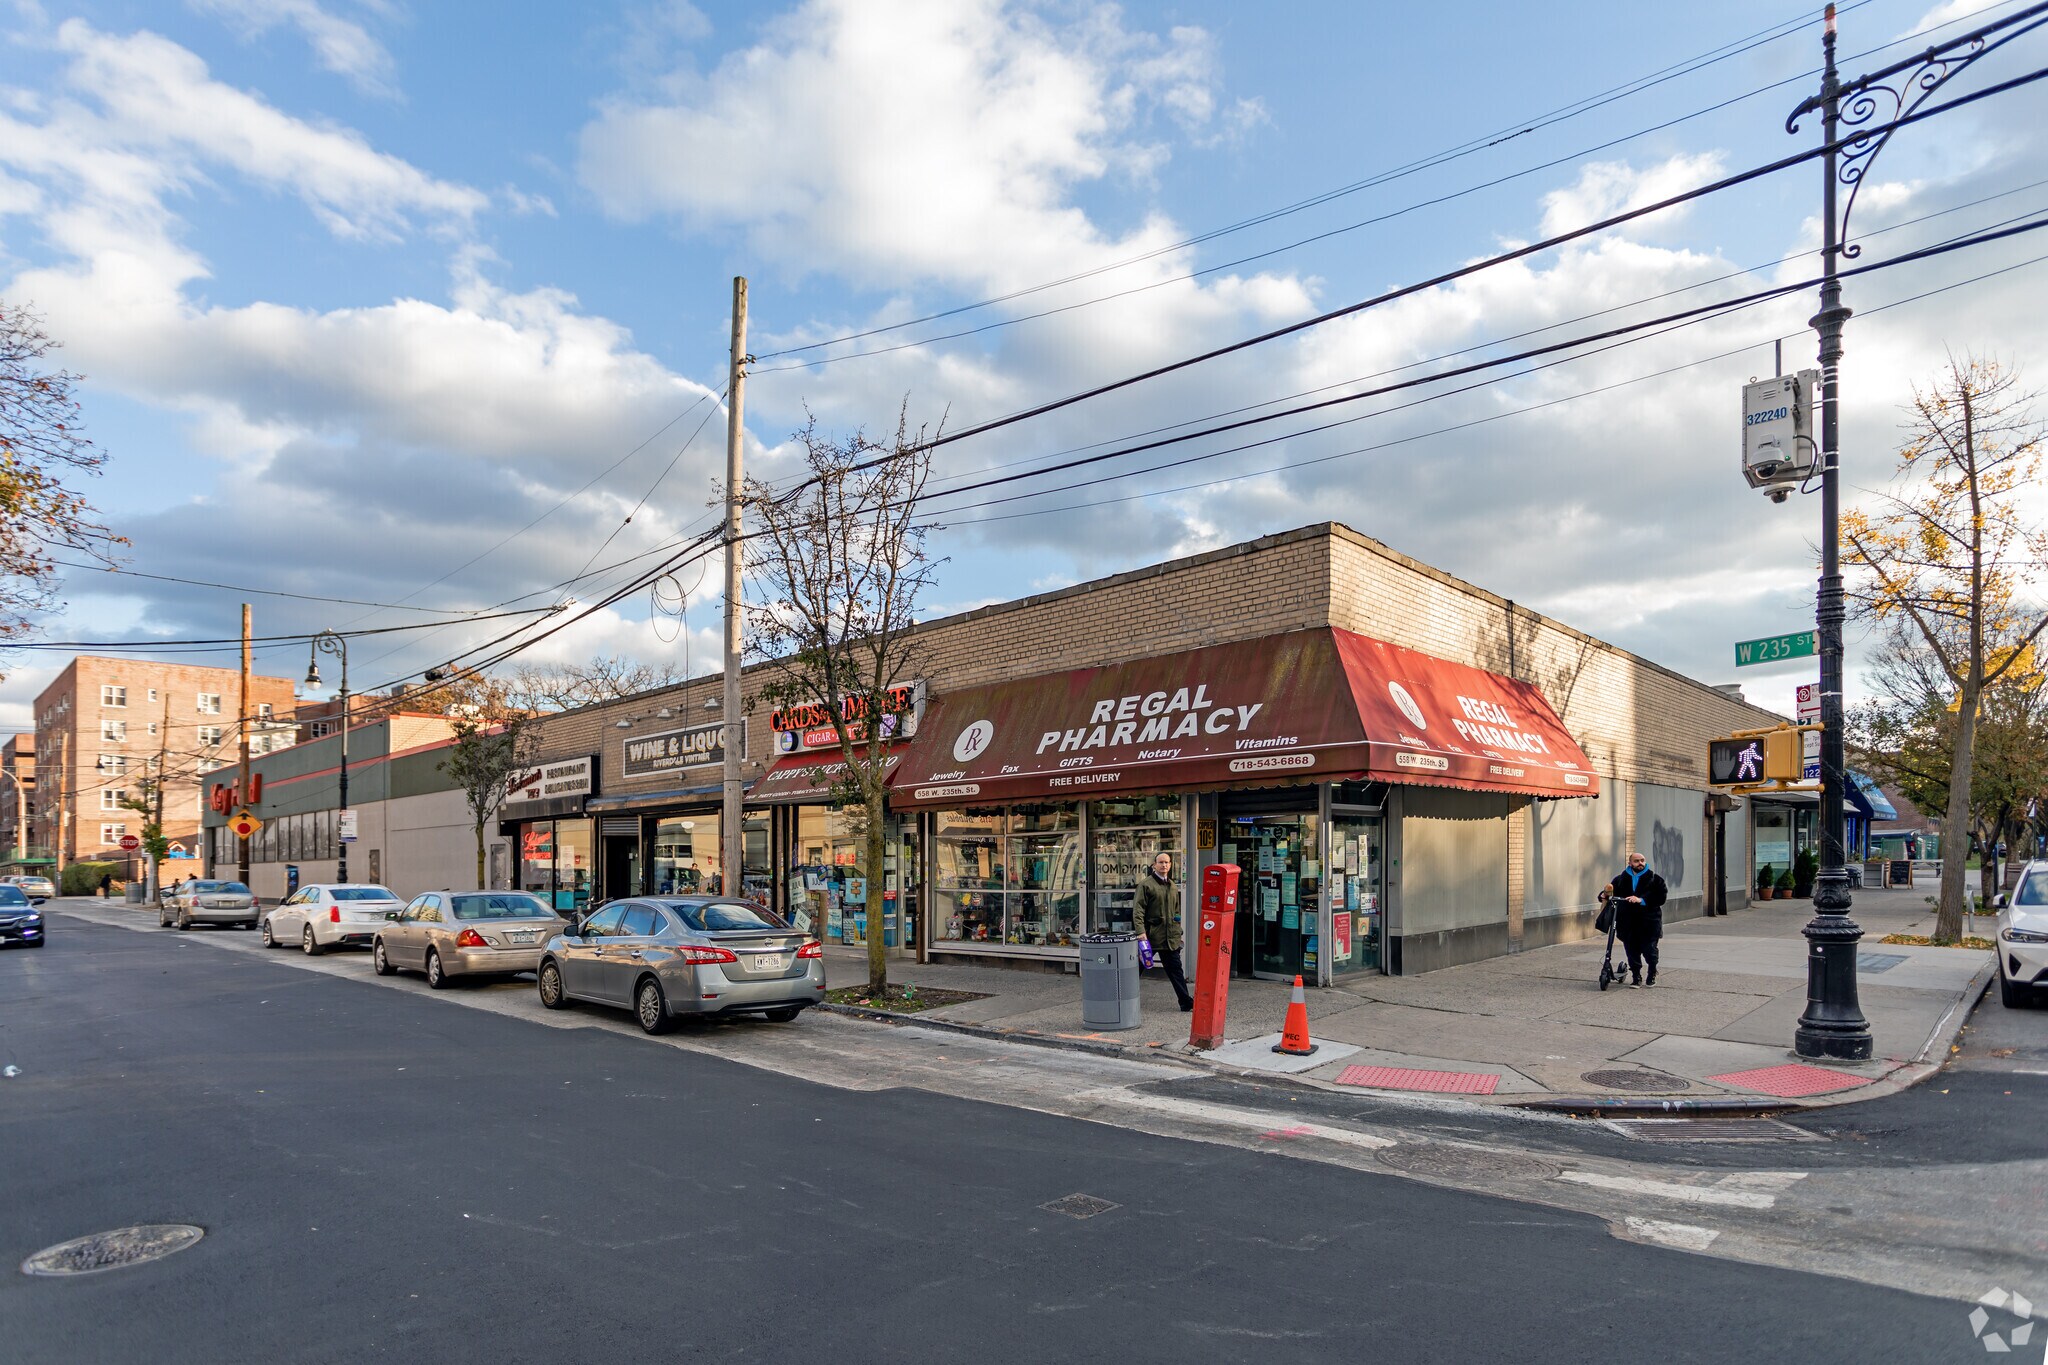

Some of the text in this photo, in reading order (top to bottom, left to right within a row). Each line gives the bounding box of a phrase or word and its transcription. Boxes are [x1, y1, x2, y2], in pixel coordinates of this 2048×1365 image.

[1747, 407, 1787, 426] 322240
[1739, 634, 1811, 663] W 235 ST
[1089, 684, 1213, 724] REGAL
[770, 703, 820, 732] CARDS
[1456, 695, 1518, 729] REGAL
[1035, 703, 1263, 755] PHARMACY
[1452, 718, 1551, 755] PHARMACY
[629, 728, 725, 761] WINE & LIQUO
[806, 733, 831, 745] CIGAR
[1234, 735, 1298, 750] Vitamins
[1399, 733, 1430, 750] Jewelry
[1059, 756, 1093, 768] GIFTS
[1137, 748, 1181, 761] Notary
[1000, 765, 1019, 775] Fax
[1233, 756, 1309, 770] 718-543-6868
[767, 767, 809, 781] CAPPY'S
[929, 769, 966, 782] Jewelry
[1490, 765, 1525, 777] FREE DELIVERY
[1049, 772, 1121, 787] FREE DELIVERY
[941, 787, 964, 796] 235th.
